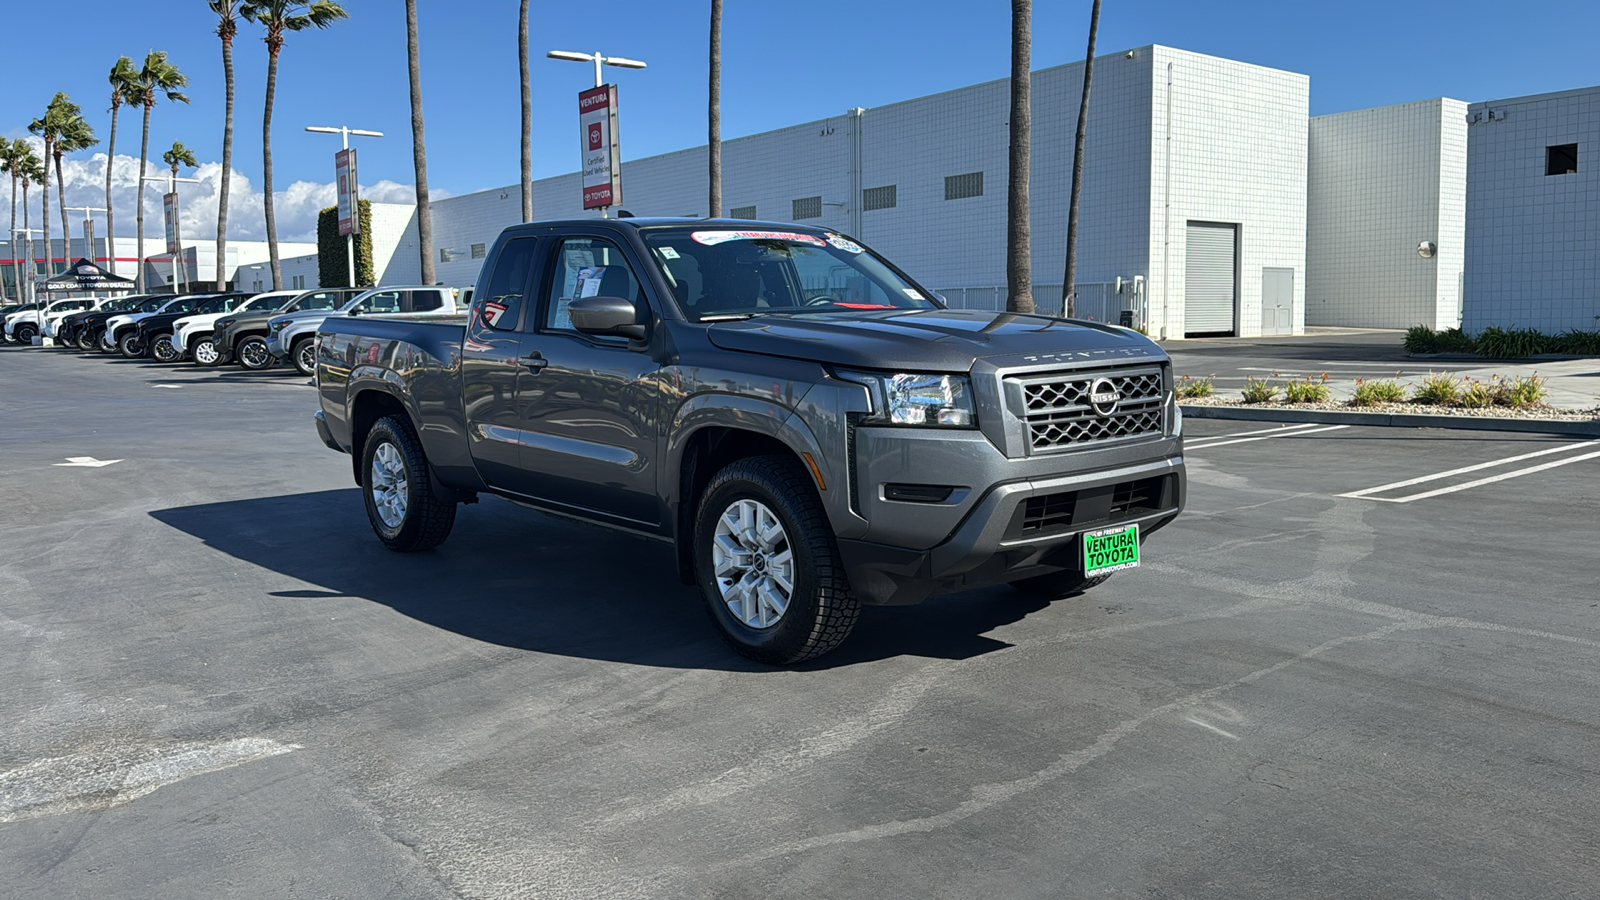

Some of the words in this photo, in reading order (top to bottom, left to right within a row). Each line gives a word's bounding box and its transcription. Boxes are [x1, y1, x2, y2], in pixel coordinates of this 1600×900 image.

[580, 93, 607, 108] VENTURA
[588, 155, 604, 166] Certified
[591, 190, 610, 200] TOYOTA
[1091, 393, 1120, 403] NISSAN
[1086, 532, 1134, 554] VENTURA
[1088, 546, 1134, 568] TOYOTA
